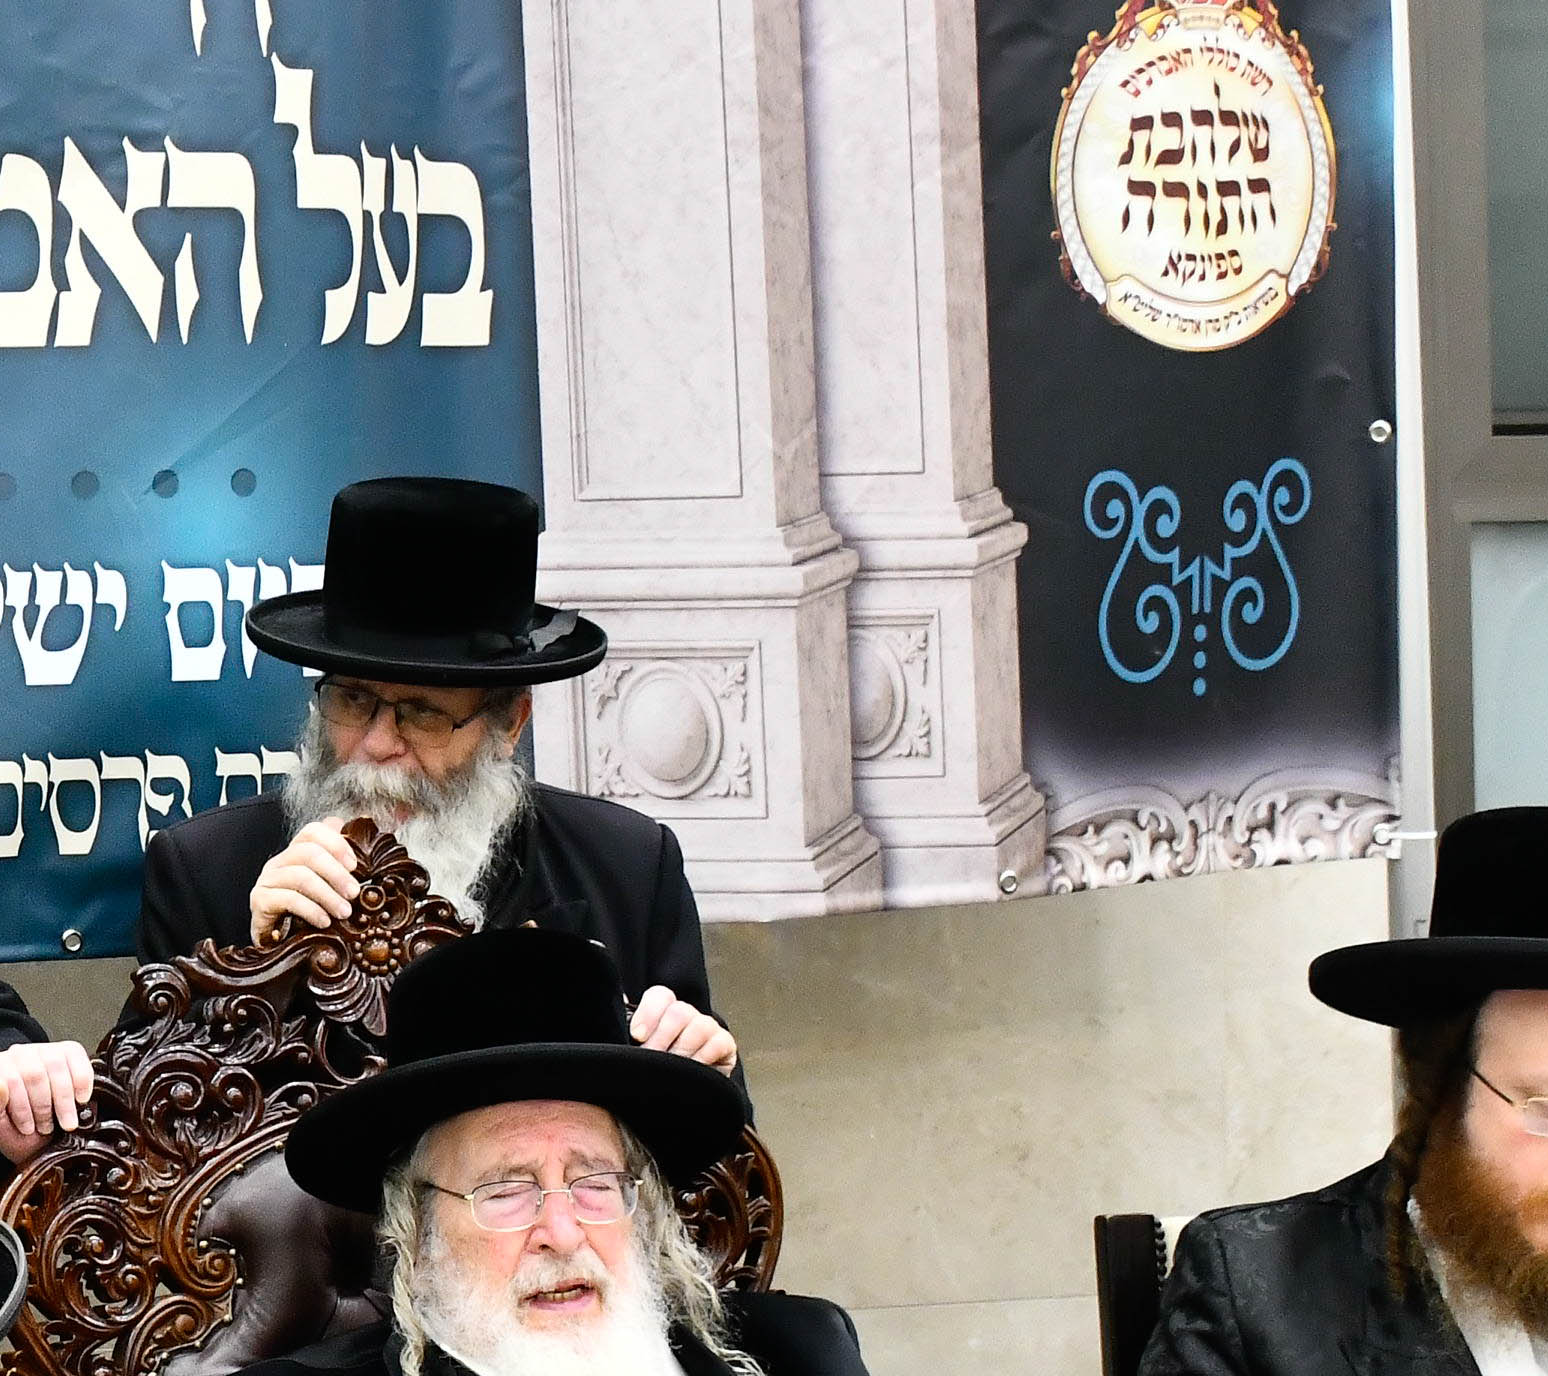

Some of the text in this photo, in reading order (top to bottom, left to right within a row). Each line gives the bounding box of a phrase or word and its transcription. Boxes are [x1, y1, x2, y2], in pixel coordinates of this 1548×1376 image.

[1117, 78, 1271, 167] שלהבת
[271, 52, 493, 346] בעל
[1121, 176, 1277, 240] התורה
[1160, 248, 1244, 288] ספינקא
